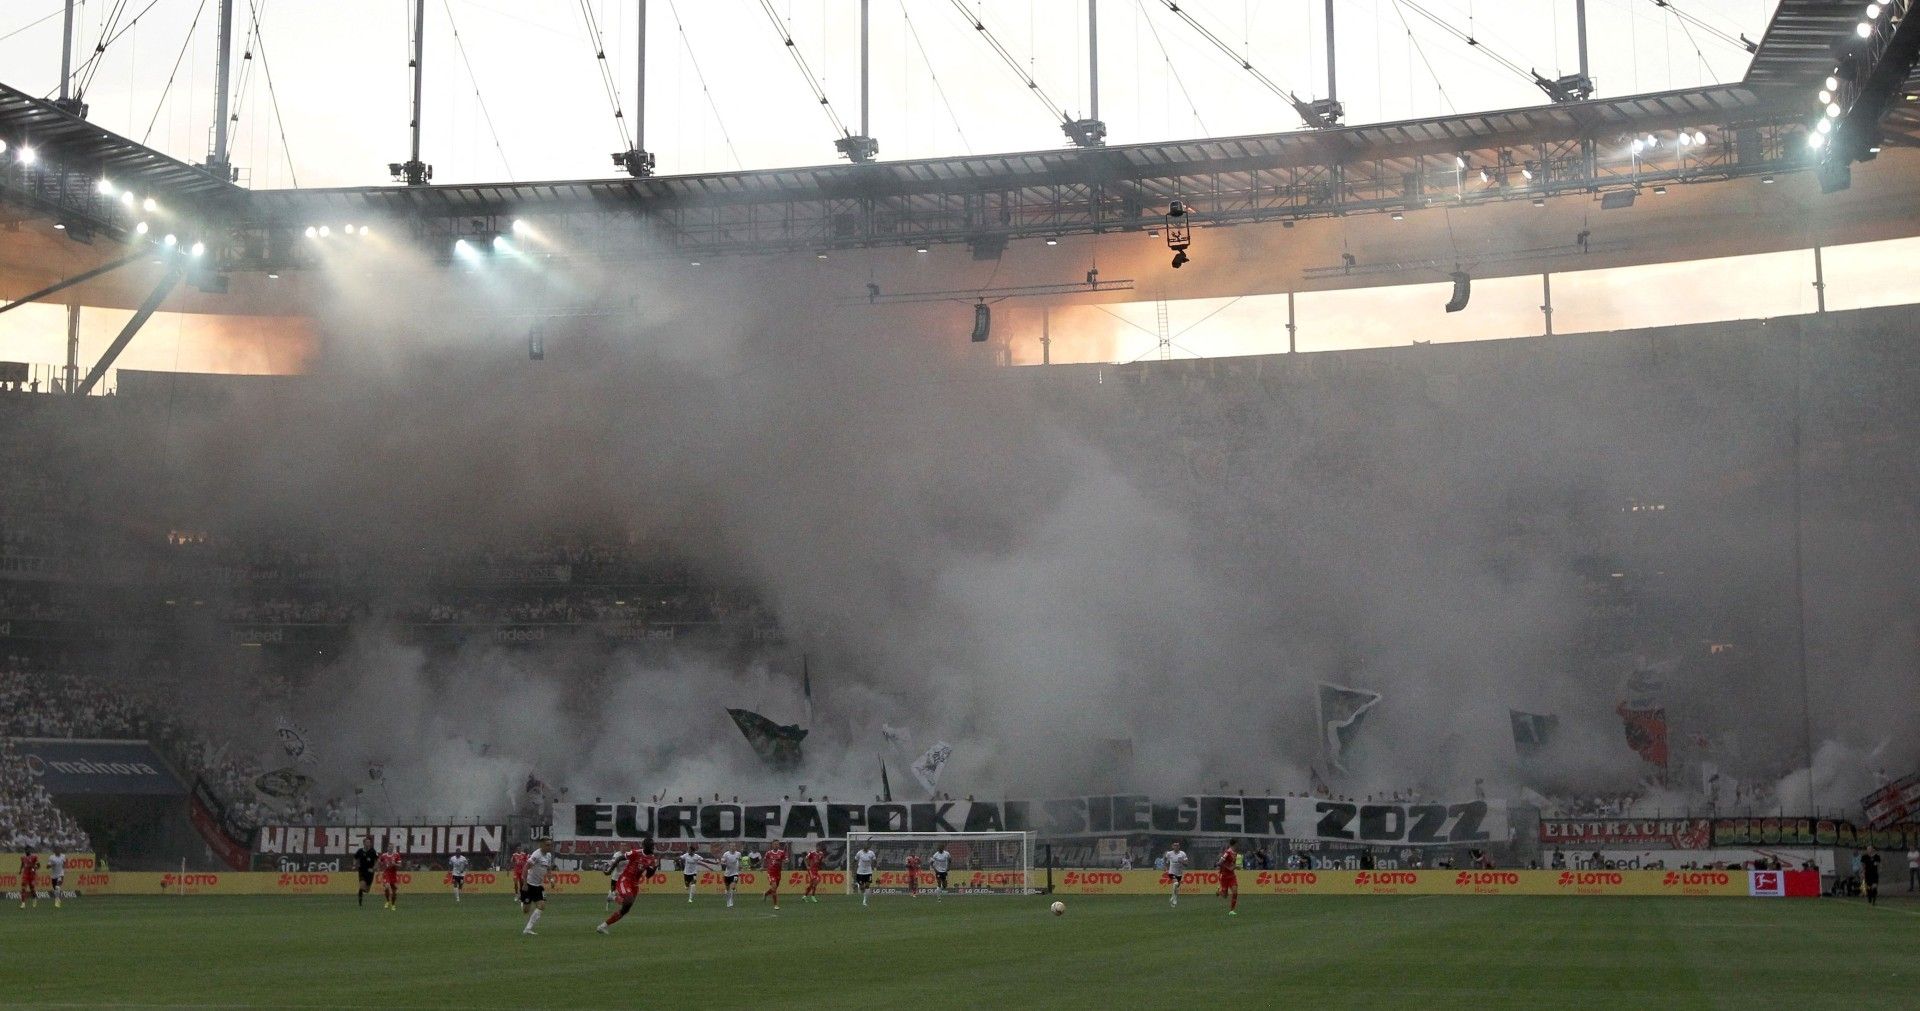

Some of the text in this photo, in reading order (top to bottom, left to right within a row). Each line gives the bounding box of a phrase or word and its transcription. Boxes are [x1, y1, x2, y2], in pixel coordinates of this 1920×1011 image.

[50, 757, 159, 776] mainova
[1316, 801, 1490, 843] 2022
[1545, 821, 1689, 836] EINTRACHT
[261, 826, 502, 854] WALDSTADION
[85, 875, 109, 886] LOTTO
[293, 873, 329, 884] LOTTO
[464, 873, 496, 884] OTTO
[1081, 873, 1122, 884] LOTTO
[1183, 873, 1218, 884] OTTO
[1274, 873, 1316, 884] LOTTO
[1373, 873, 1416, 884] LOTTO
[1474, 873, 1518, 884] LOTTO
[1578, 873, 1622, 884] LOTTO
[1683, 873, 1729, 884] LOTTO
